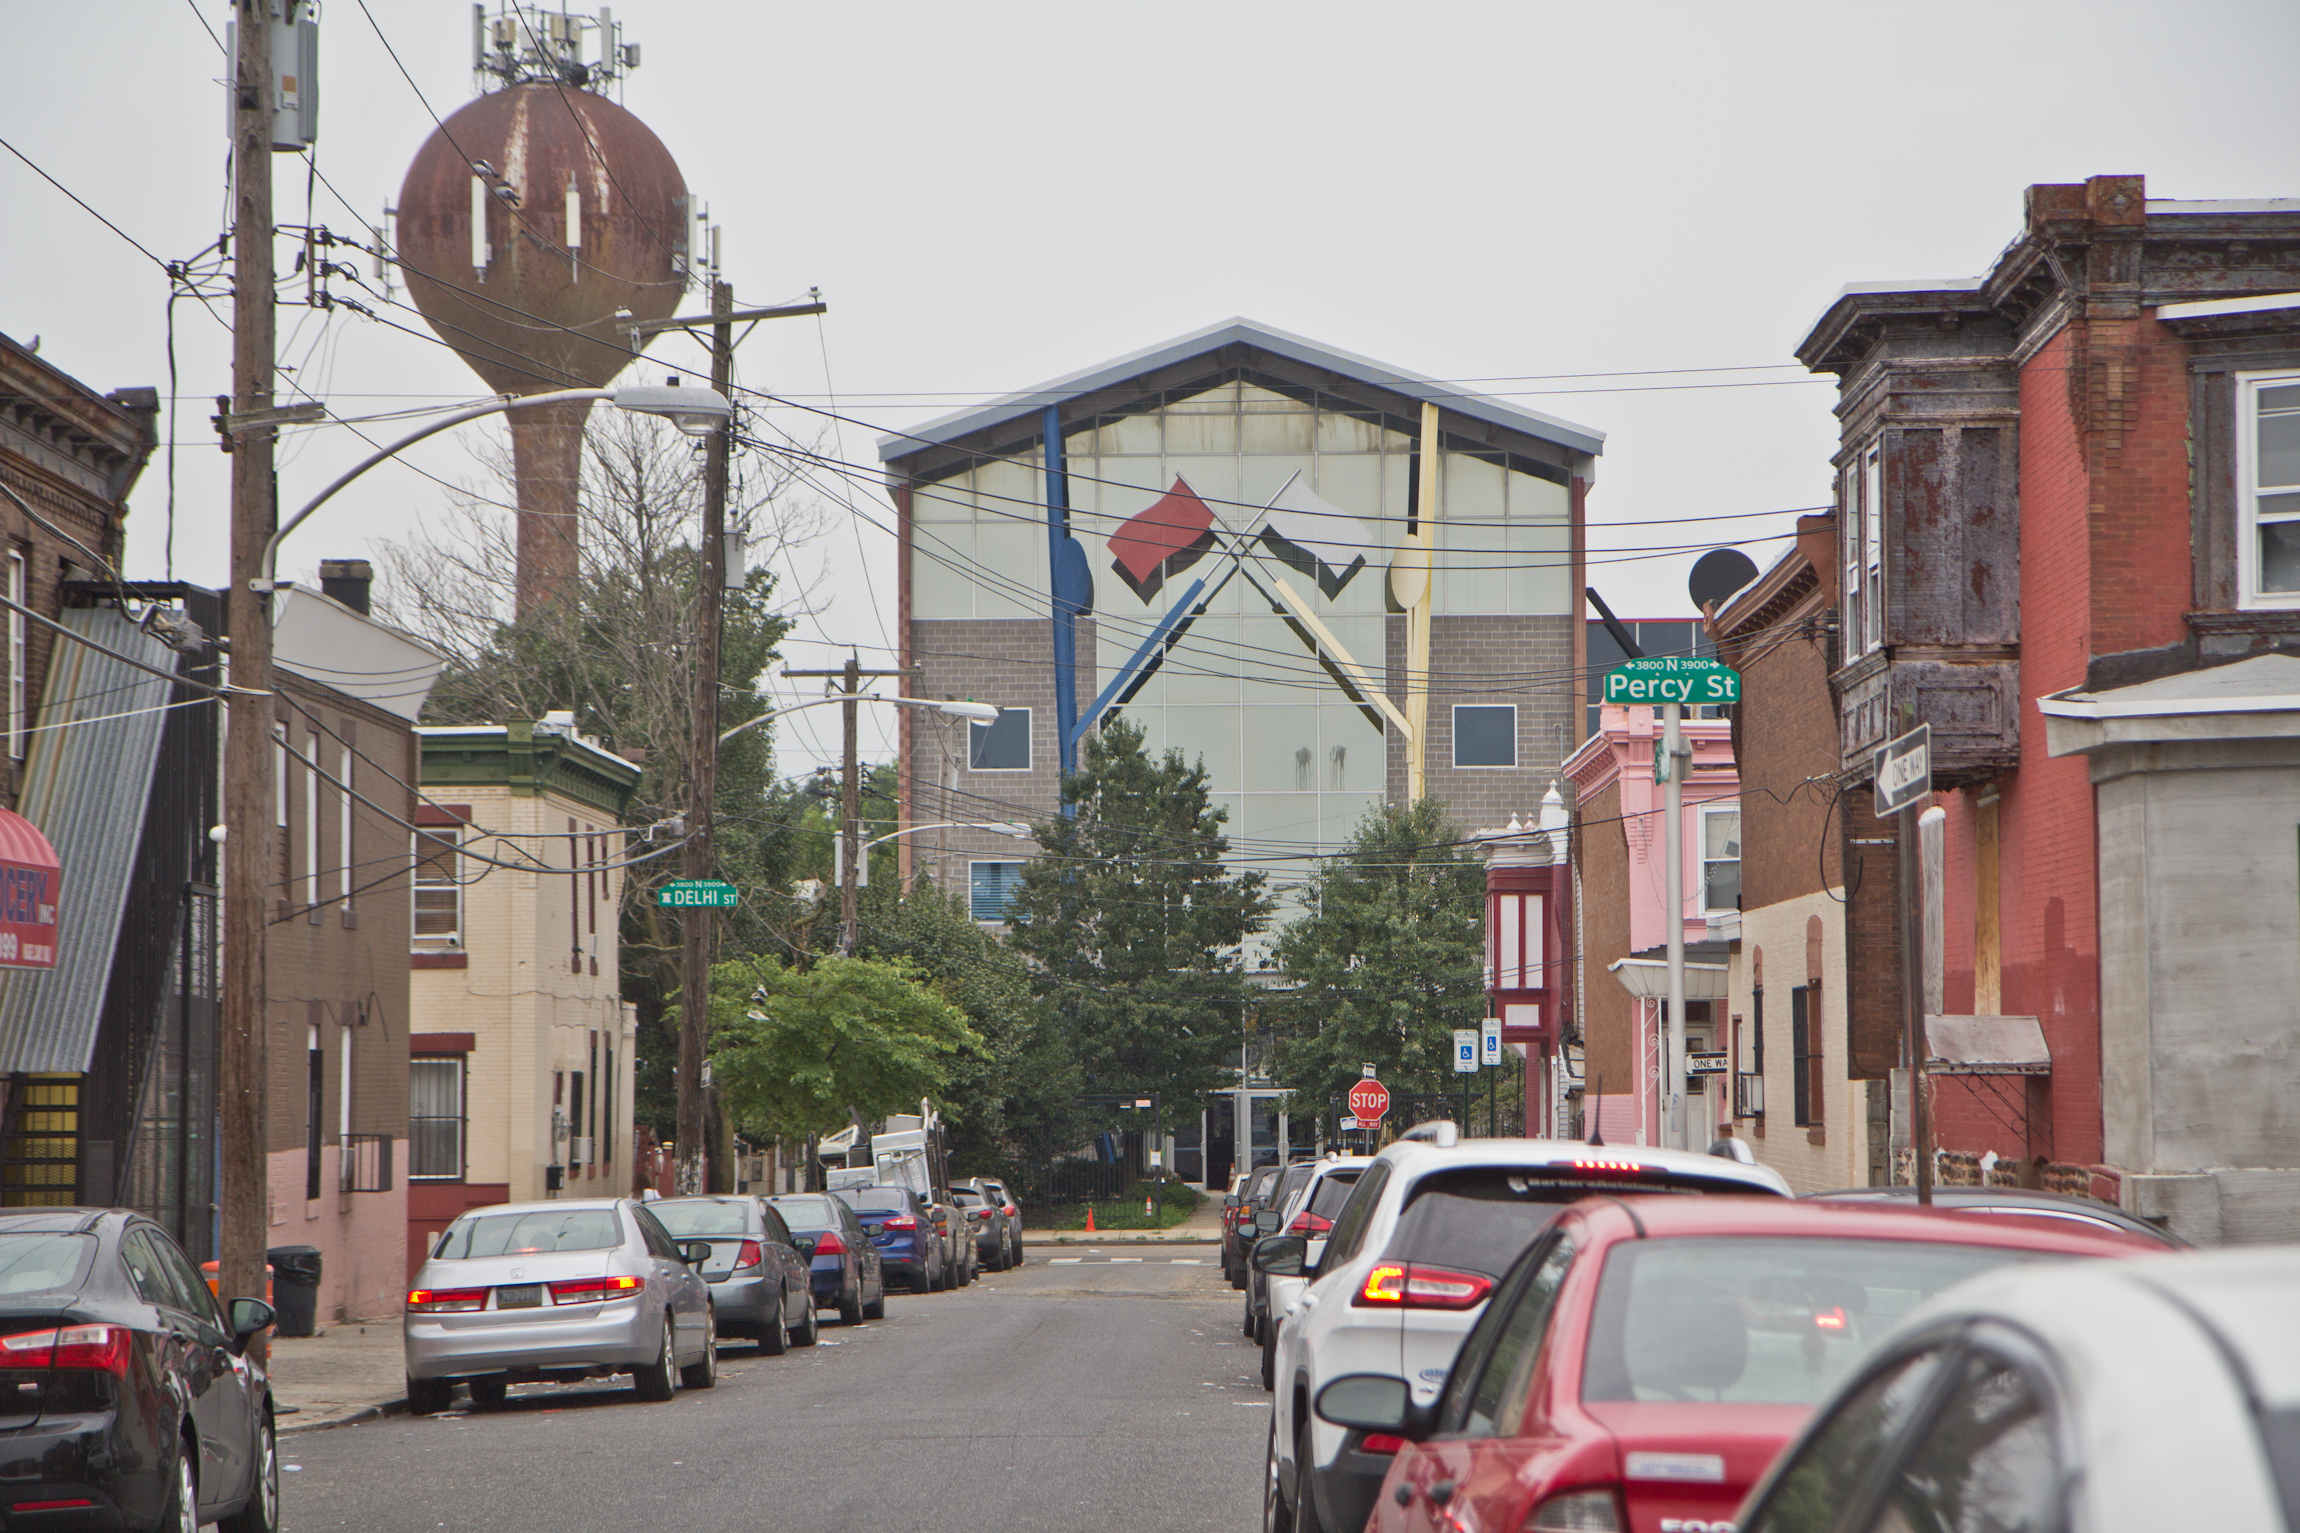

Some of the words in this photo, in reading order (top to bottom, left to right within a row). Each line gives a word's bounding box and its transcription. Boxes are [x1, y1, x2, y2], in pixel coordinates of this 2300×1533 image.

[1635, 661, 1664, 670] 3800
[1666, 659, 1678, 671] N
[1680, 660, 1709, 669] 3900
[1610, 674, 1694, 702] Percy
[1707, 675, 1735, 698] St
[1893, 757, 1908, 787] ONE
[1909, 747, 1924, 779] WAY
[675, 890, 718, 905] DELHI
[723, 894, 736, 904] ST
[1694, 1059, 1712, 1068] ONE
[1715, 1058, 1728, 1067] WA
[1352, 1092, 1387, 1108] STOP
